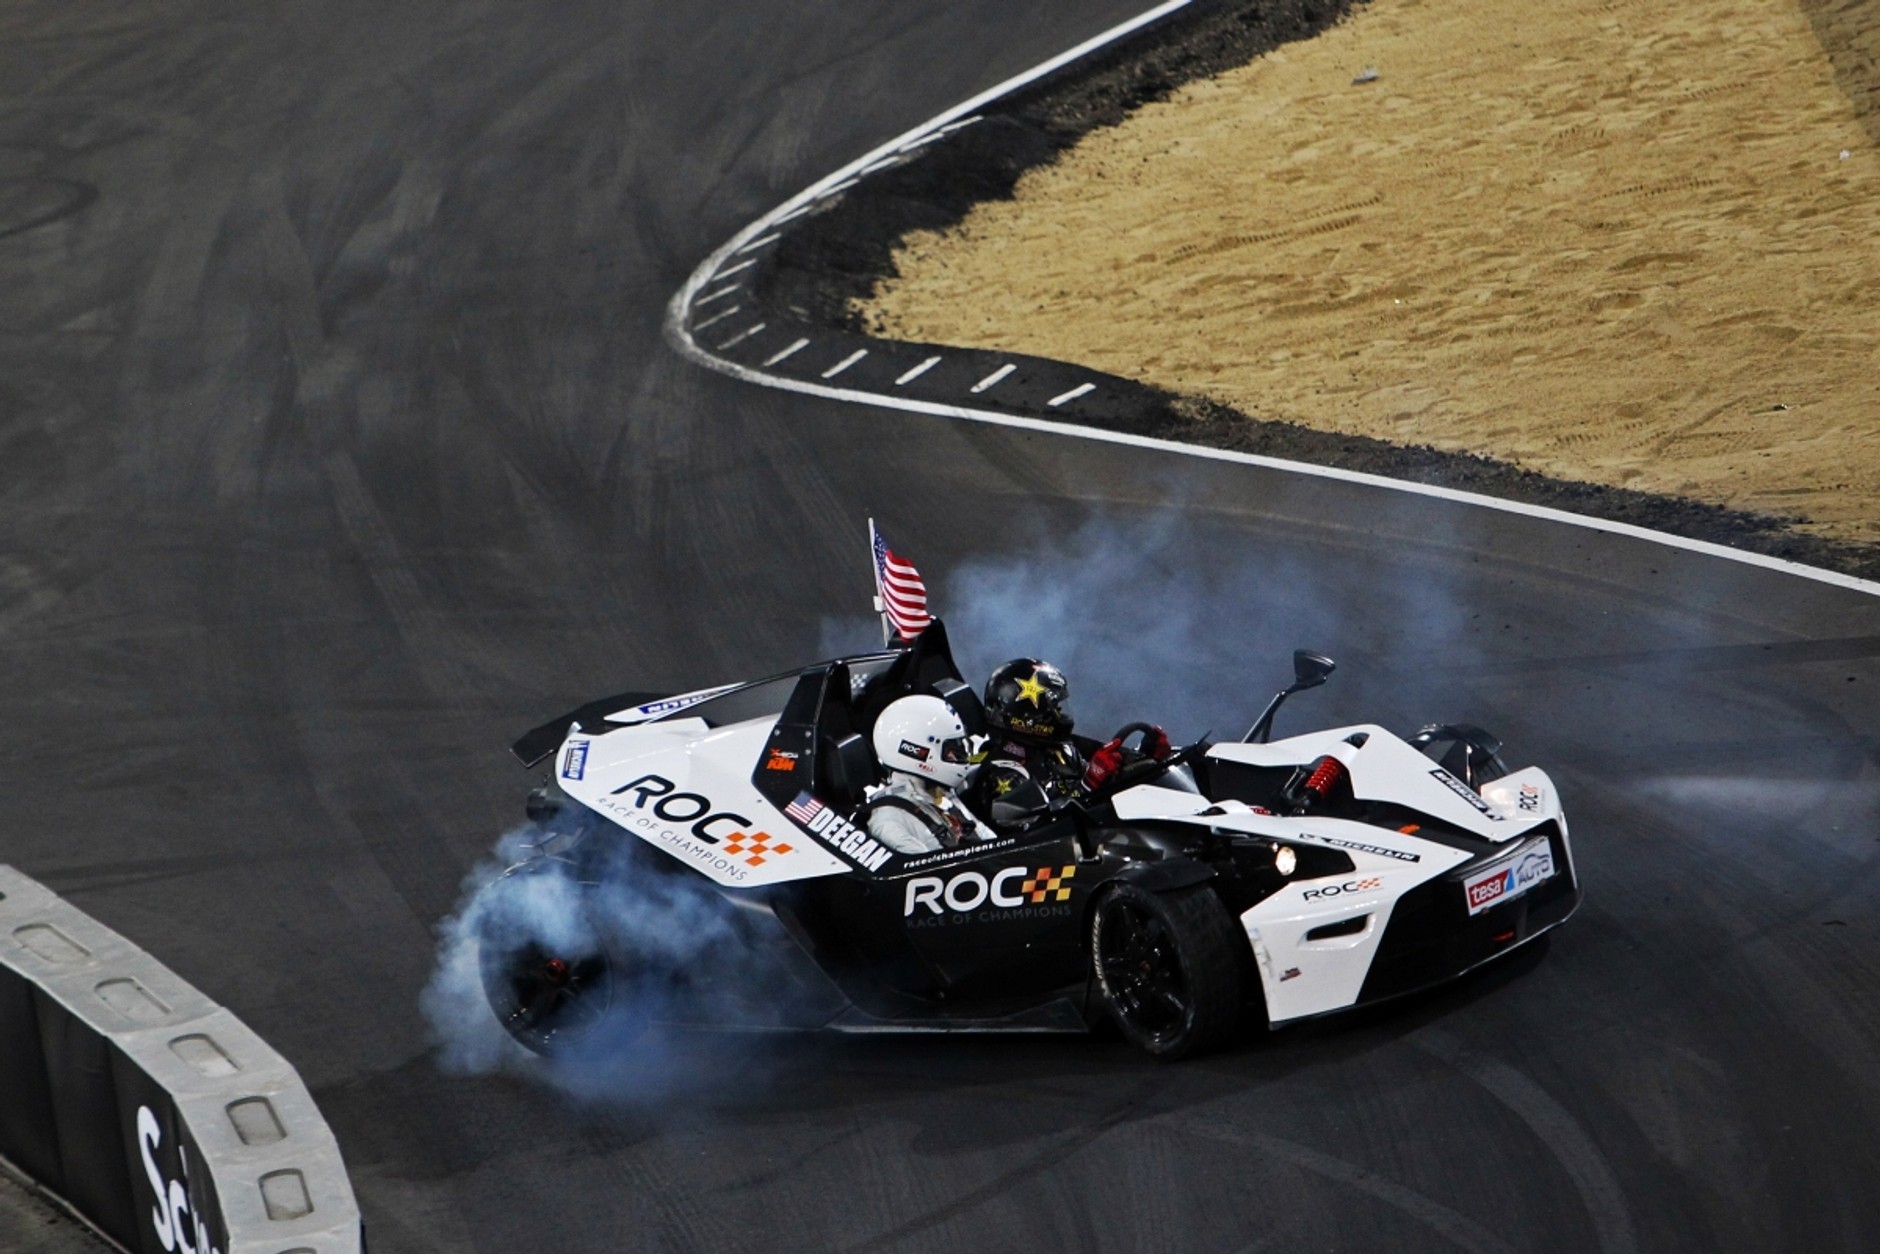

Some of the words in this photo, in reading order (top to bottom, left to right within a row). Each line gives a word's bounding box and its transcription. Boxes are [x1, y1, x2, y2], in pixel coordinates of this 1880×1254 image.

[610, 774, 753, 845] ROC
[1519, 791, 1538, 812] ROC
[597, 798, 635, 822] RACE
[636, 816, 659, 832] OF
[660, 830, 748, 881] CHAMPIONS
[807, 806, 893, 873] DEEGAN
[904, 838, 1015, 869] raceofchampions.com
[1330, 839, 1414, 861] MICHELIN
[904, 866, 1028, 917] ROC
[1302, 881, 1359, 901] ROC
[1471, 879, 1501, 903] tesa
[1518, 858, 1550, 886] AUTO
[907, 914, 946, 930] RACE
[952, 912, 973, 926] OF
[979, 905, 1072, 923] CHAMPIONS
